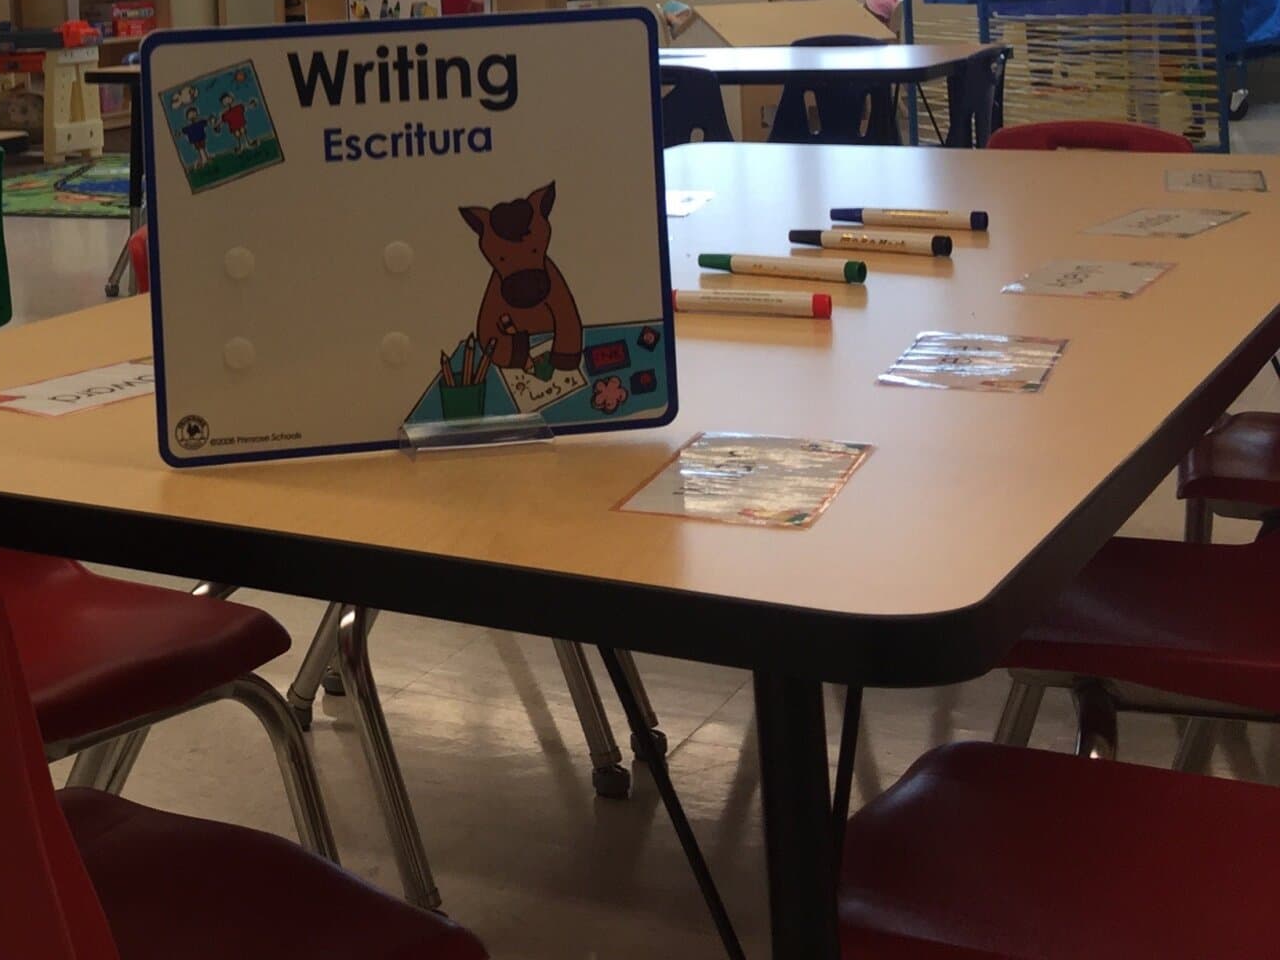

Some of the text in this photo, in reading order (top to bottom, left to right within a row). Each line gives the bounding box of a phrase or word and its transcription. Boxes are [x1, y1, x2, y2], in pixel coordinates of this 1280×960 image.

[288, 43, 519, 111] Writing
[324, 123, 493, 162] Escritura
[271, 431, 302, 442] Schools
